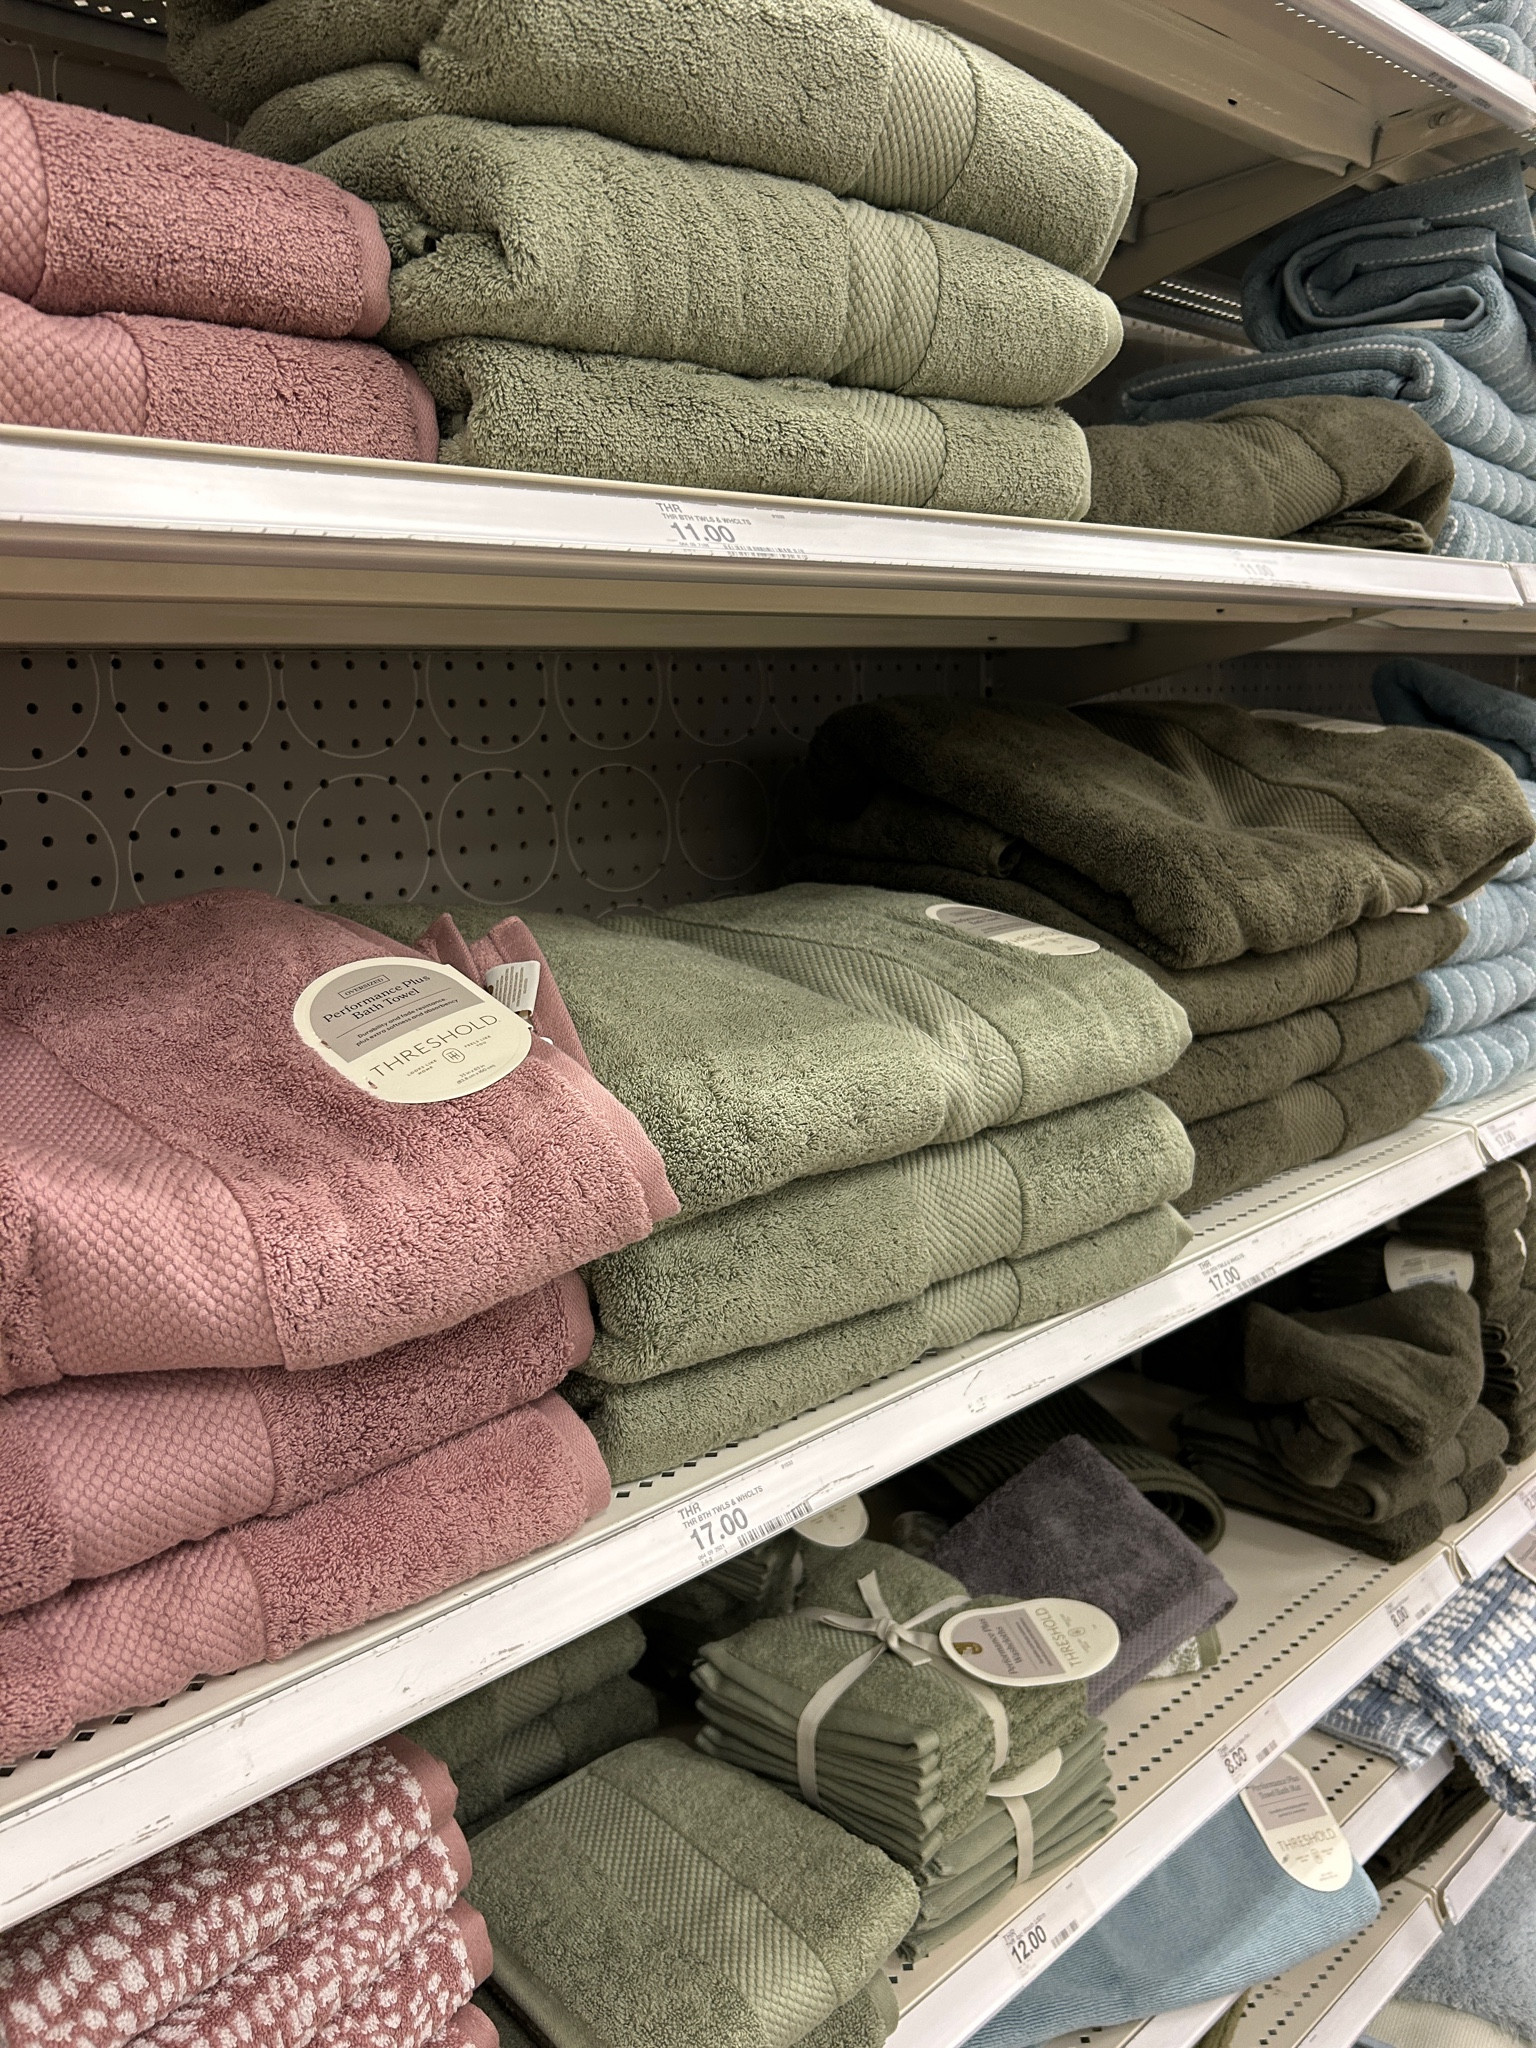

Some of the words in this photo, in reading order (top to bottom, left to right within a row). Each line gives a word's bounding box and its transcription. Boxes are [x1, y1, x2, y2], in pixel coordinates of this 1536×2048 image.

[656, 502, 683, 513] THR
[670, 522, 736, 543] 11.00
[322, 984, 403, 1023] Performance
[402, 975, 431, 989] Plus
[344, 978, 384, 996] OVERSIZED
[351, 1003, 385, 1020] Bath
[382, 988, 420, 1005] Towel
[356, 1038, 370, 1047] plus
[369, 1029, 387, 1042] extra
[386, 1018, 412, 1031] softness
[411, 1011, 424, 1020] and
[424, 999, 459, 1015] absorbency
[357, 1022, 388, 1039] Durability
[388, 1015, 402, 1024] and
[401, 1010, 416, 1019] fade
[369, 1015, 498, 1077] THRESHOLD
[1208, 1266, 1240, 1291] 17.00
[677, 1502, 701, 1520] THR
[682, 1517, 698, 1529] THR
[697, 1510, 712, 1522] BTH
[711, 1501, 731, 1514] TWLS
[730, 1498, 736, 1506] &
[690, 1507, 748, 1550] 17.00
[1035, 1607, 1084, 1667] THRESHOLD
[1224, 1746, 1247, 1774] 8.00
[1277, 1828, 1337, 1852] THRESHOLD
[1011, 1925, 1047, 1964] 12.00
